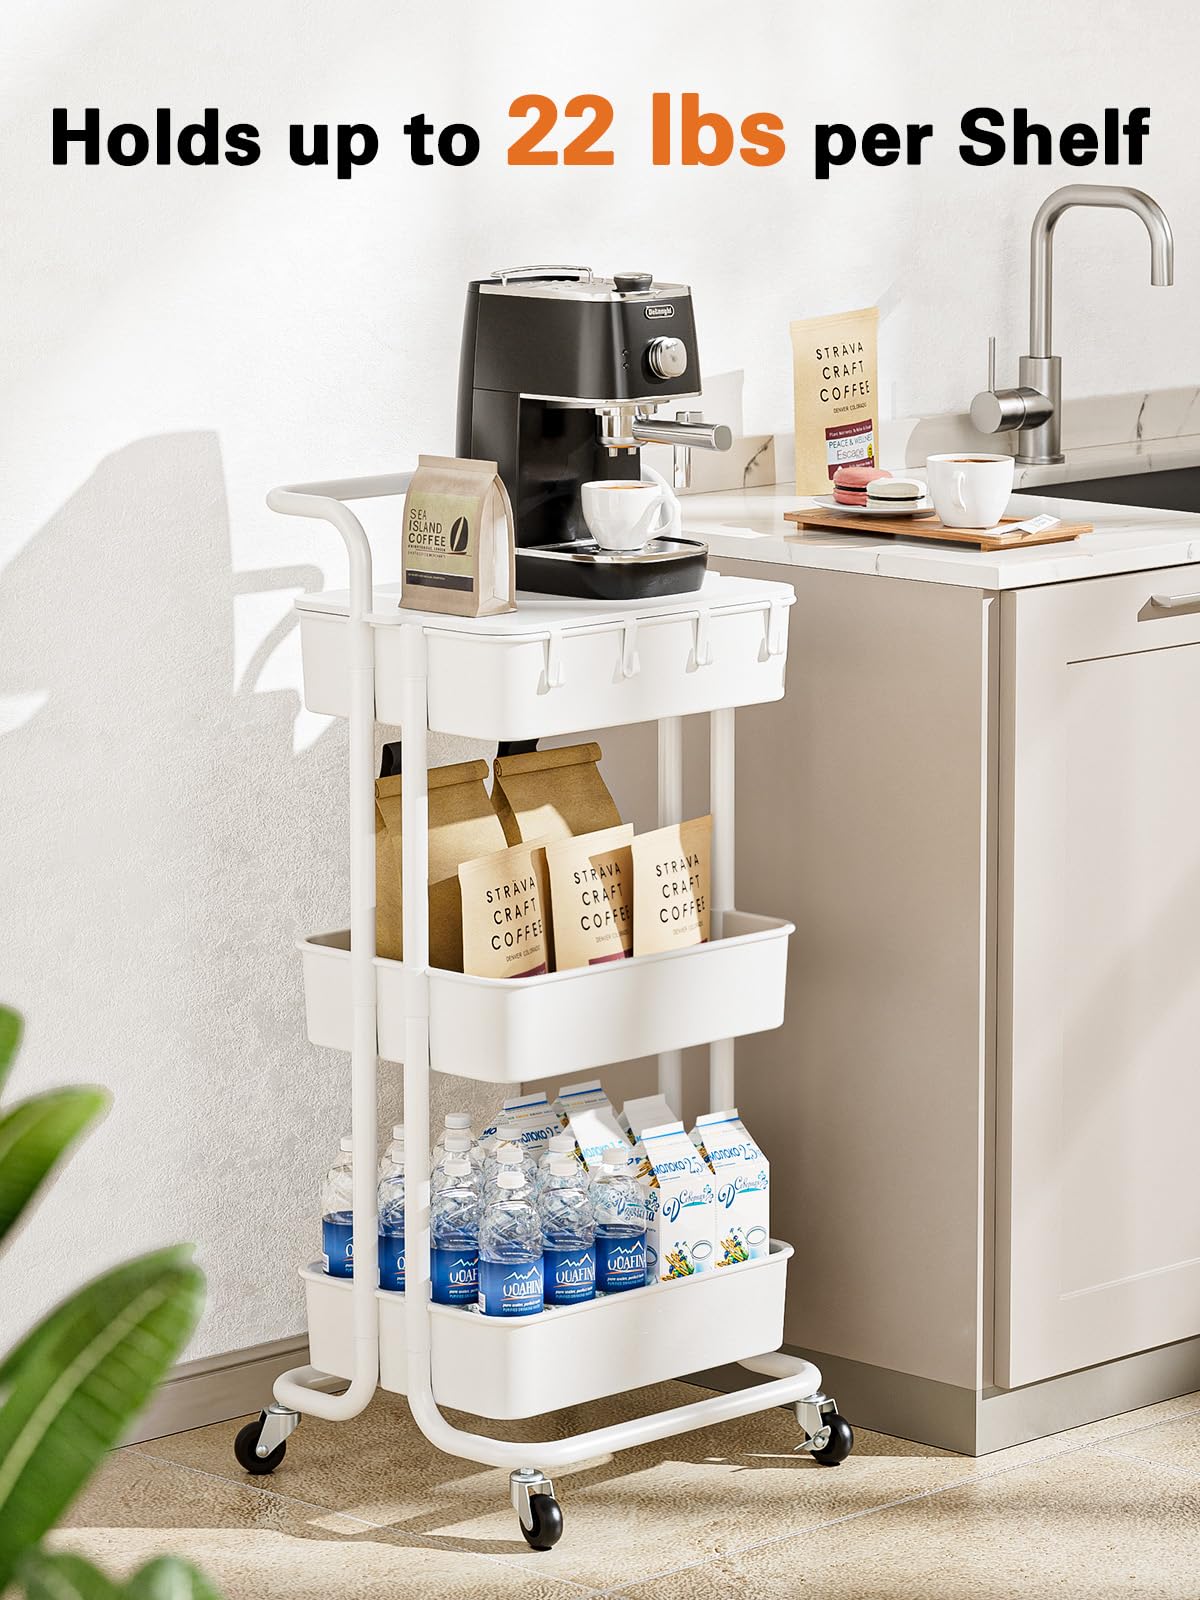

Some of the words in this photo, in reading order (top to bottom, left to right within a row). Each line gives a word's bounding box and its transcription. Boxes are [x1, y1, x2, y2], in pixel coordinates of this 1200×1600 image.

[822, 360, 863, 380] CRAFT
[819, 380, 870, 402] COFFEE
[409, 508, 427, 520] SEA
[408, 520, 443, 534] ISLAND
[408, 532, 446, 547] COFFEE
[581, 883, 623, 906] CRAFT
[662, 874, 701, 899] CRAFT
[493, 897, 537, 925] CRAFT
[580, 905, 631, 931] COFFEE
[659, 896, 705, 923] COFFEE
[491, 919, 543, 951] COFFEE
